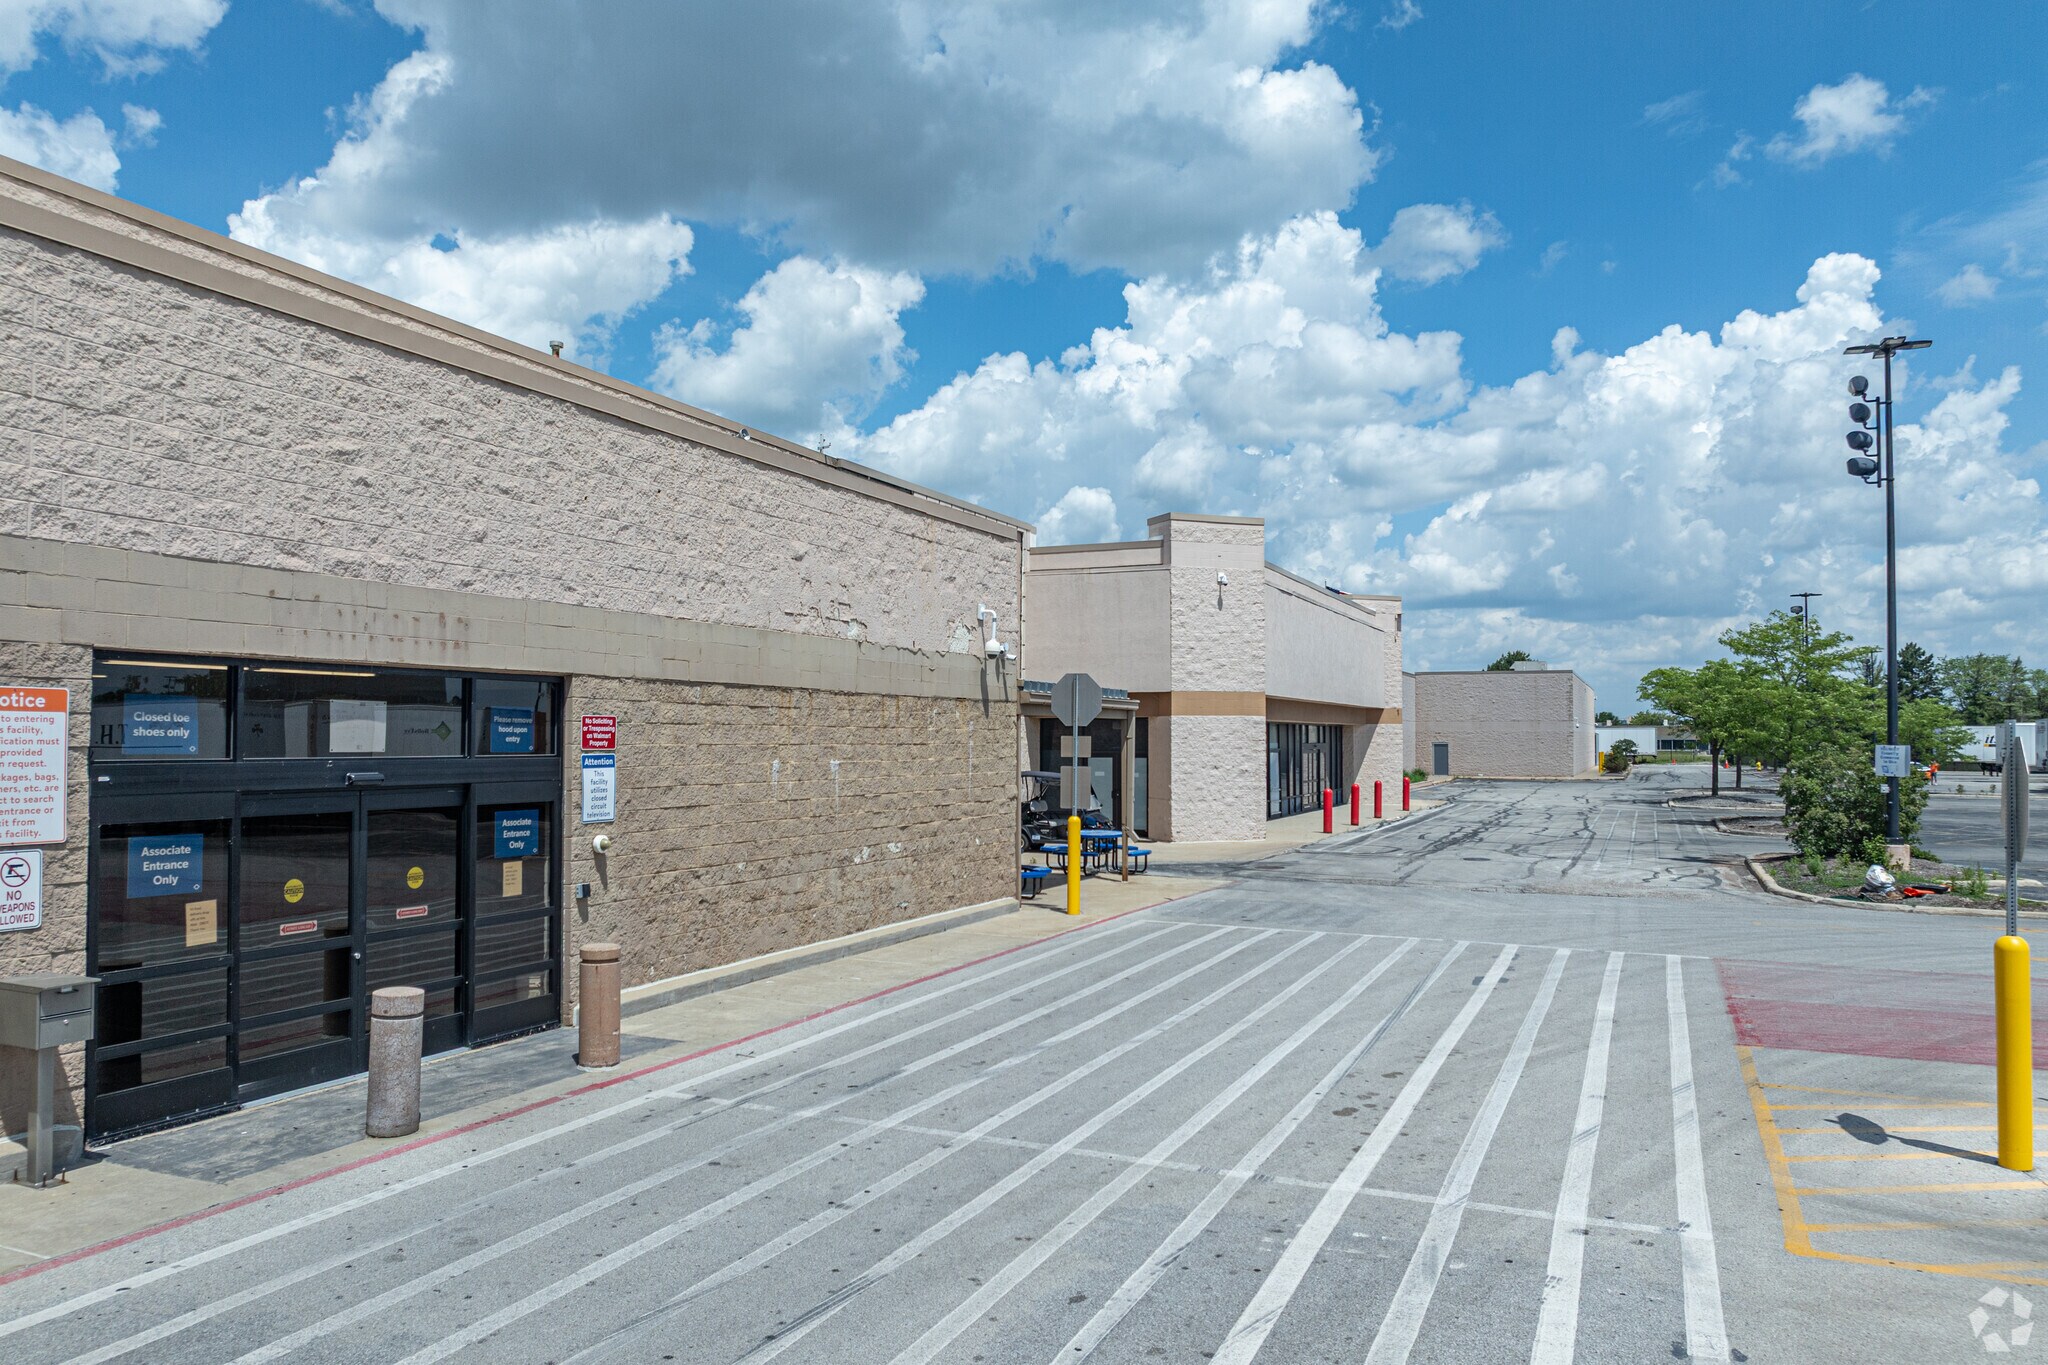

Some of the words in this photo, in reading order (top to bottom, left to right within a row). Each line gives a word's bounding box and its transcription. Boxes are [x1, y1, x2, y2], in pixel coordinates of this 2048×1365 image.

[1, 715, 11, 724] to
[14, 715, 55, 725] entering
[133, 711, 171, 722] Closed
[173, 712, 190, 723] toe
[493, 715, 511, 723] Please
[593, 717, 613, 726] Soliciting
[6, 725, 43, 735] facility,
[133, 726, 165, 737] shoes
[166, 727, 190, 739] only
[498, 725, 513, 733] hood
[588, 725, 615, 733] Trespassing
[36, 737, 60, 746] must
[505, 736, 521, 744] entry
[589, 740, 609, 748] Property
[0, 748, 43, 759] provided
[8, 760, 47, 769] request.
[584, 757, 614, 766] Attention
[34, 772, 59, 783] bags,
[590, 778, 608, 787] facility
[23, 784, 42, 793] etc.
[44, 785, 59, 793] are
[10, 795, 20, 804] to
[23, 794, 54, 804] search
[591, 794, 608, 802] closed
[0, 806, 41, 816] entrance
[44, 807, 54, 815] or
[591, 802, 607, 810] circuit
[586, 810, 611, 819] television
[12, 817, 35, 827] from
[502, 817, 532, 827] Associate
[5, 829, 41, 839] facility.
[503, 829, 530, 839] Entrance
[509, 841, 525, 850] Only
[141, 845, 191, 857] Associate
[143, 860, 189, 872] Entrance
[153, 875, 179, 886] Only
[6, 890, 22, 901] NO
